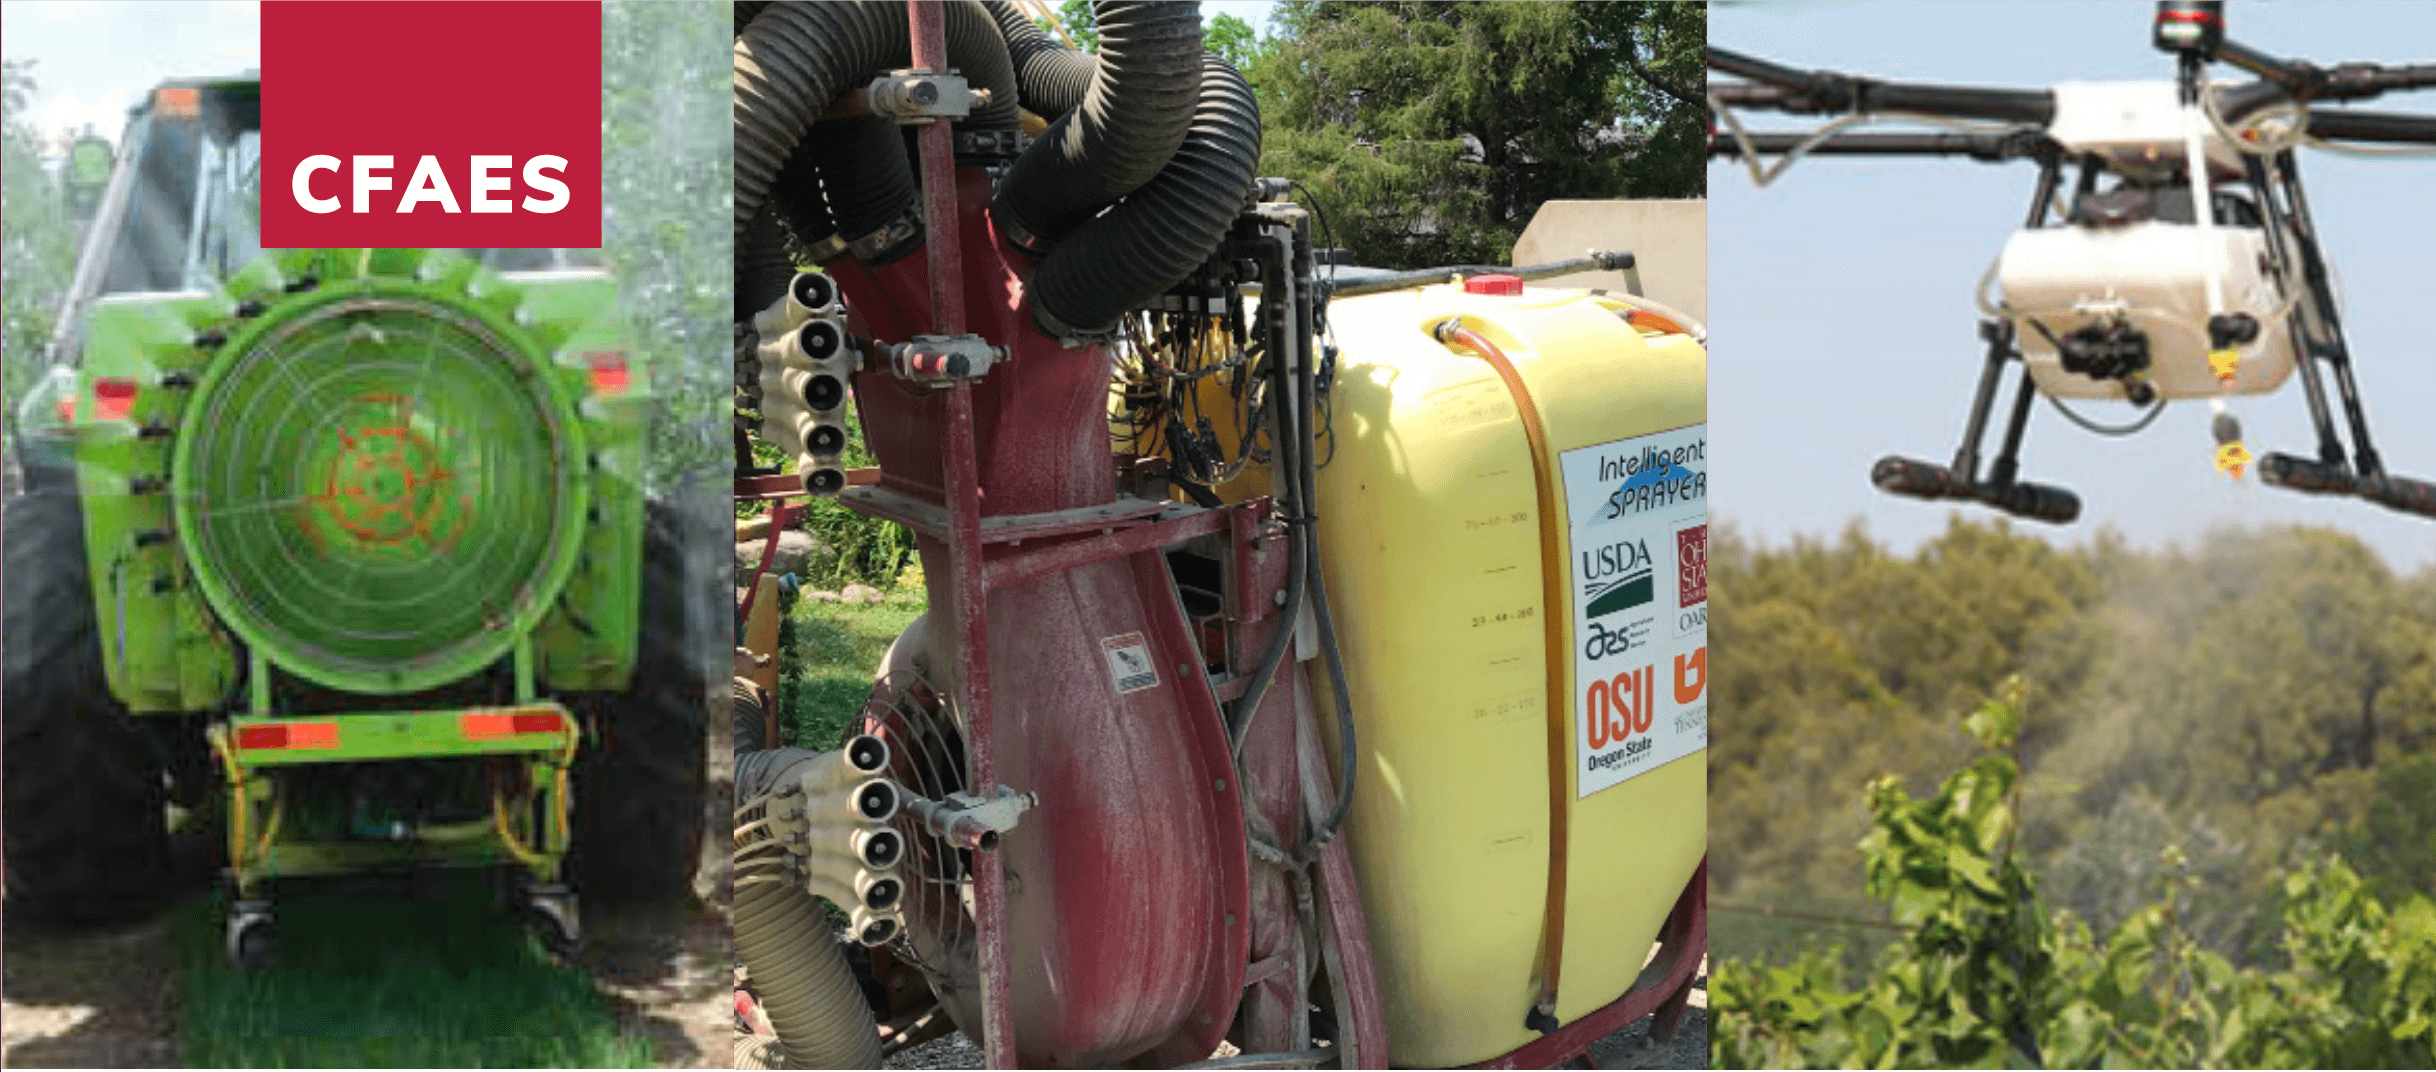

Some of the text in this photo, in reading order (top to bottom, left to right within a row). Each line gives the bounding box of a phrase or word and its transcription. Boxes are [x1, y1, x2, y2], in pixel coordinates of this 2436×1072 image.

[1599, 439, 1706, 482] Intelligent
[1607, 472, 1707, 519] SPRAYER
[1583, 537, 1653, 581] USDA
[1587, 664, 1654, 750] OSU
[1588, 736, 1652, 771] Oregon State
